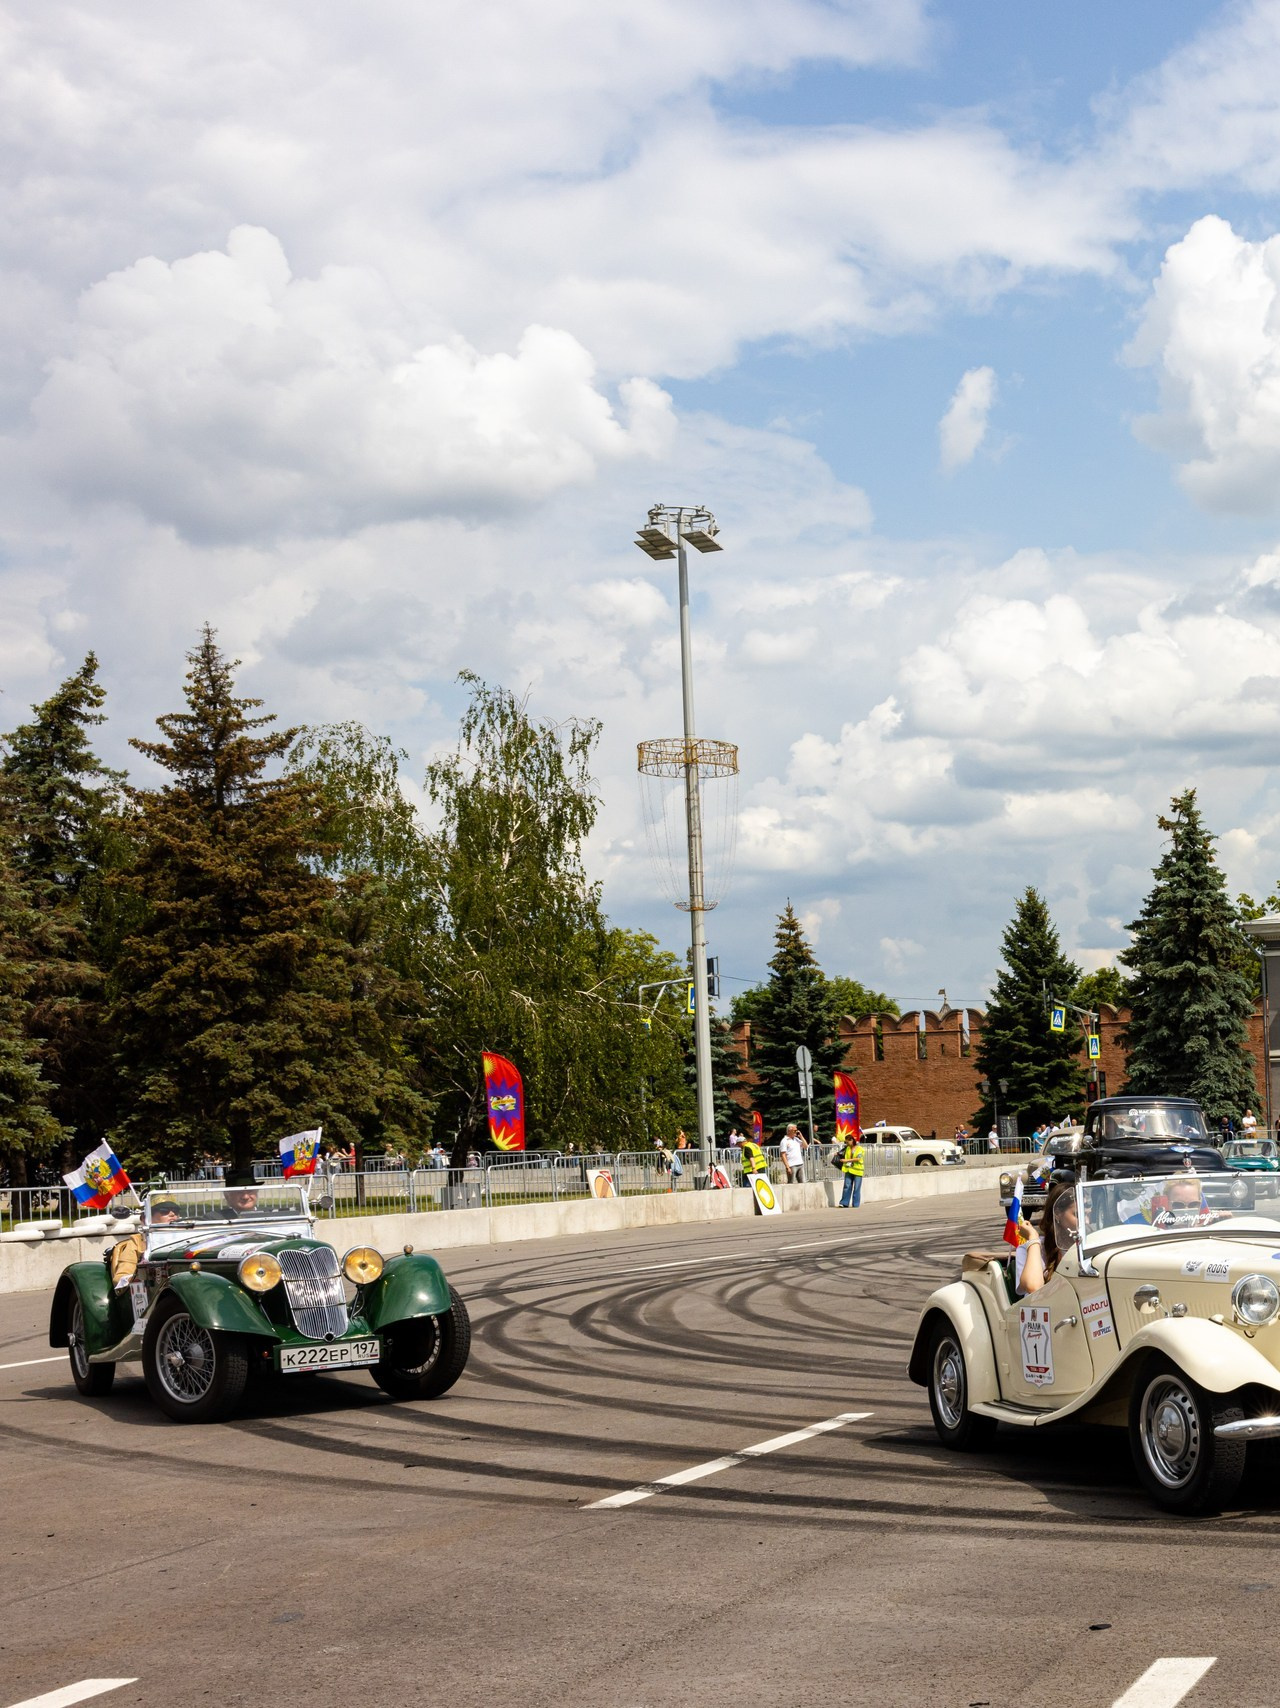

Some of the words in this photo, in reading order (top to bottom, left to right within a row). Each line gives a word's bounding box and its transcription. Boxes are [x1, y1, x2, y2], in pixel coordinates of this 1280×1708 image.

[1082, 1300, 1108, 1314] auto.ru
[353, 1342, 376, 1355] 197
[1033, 1343, 1039, 1365] 1
[287, 1348, 349, 1366] К222ЕР
